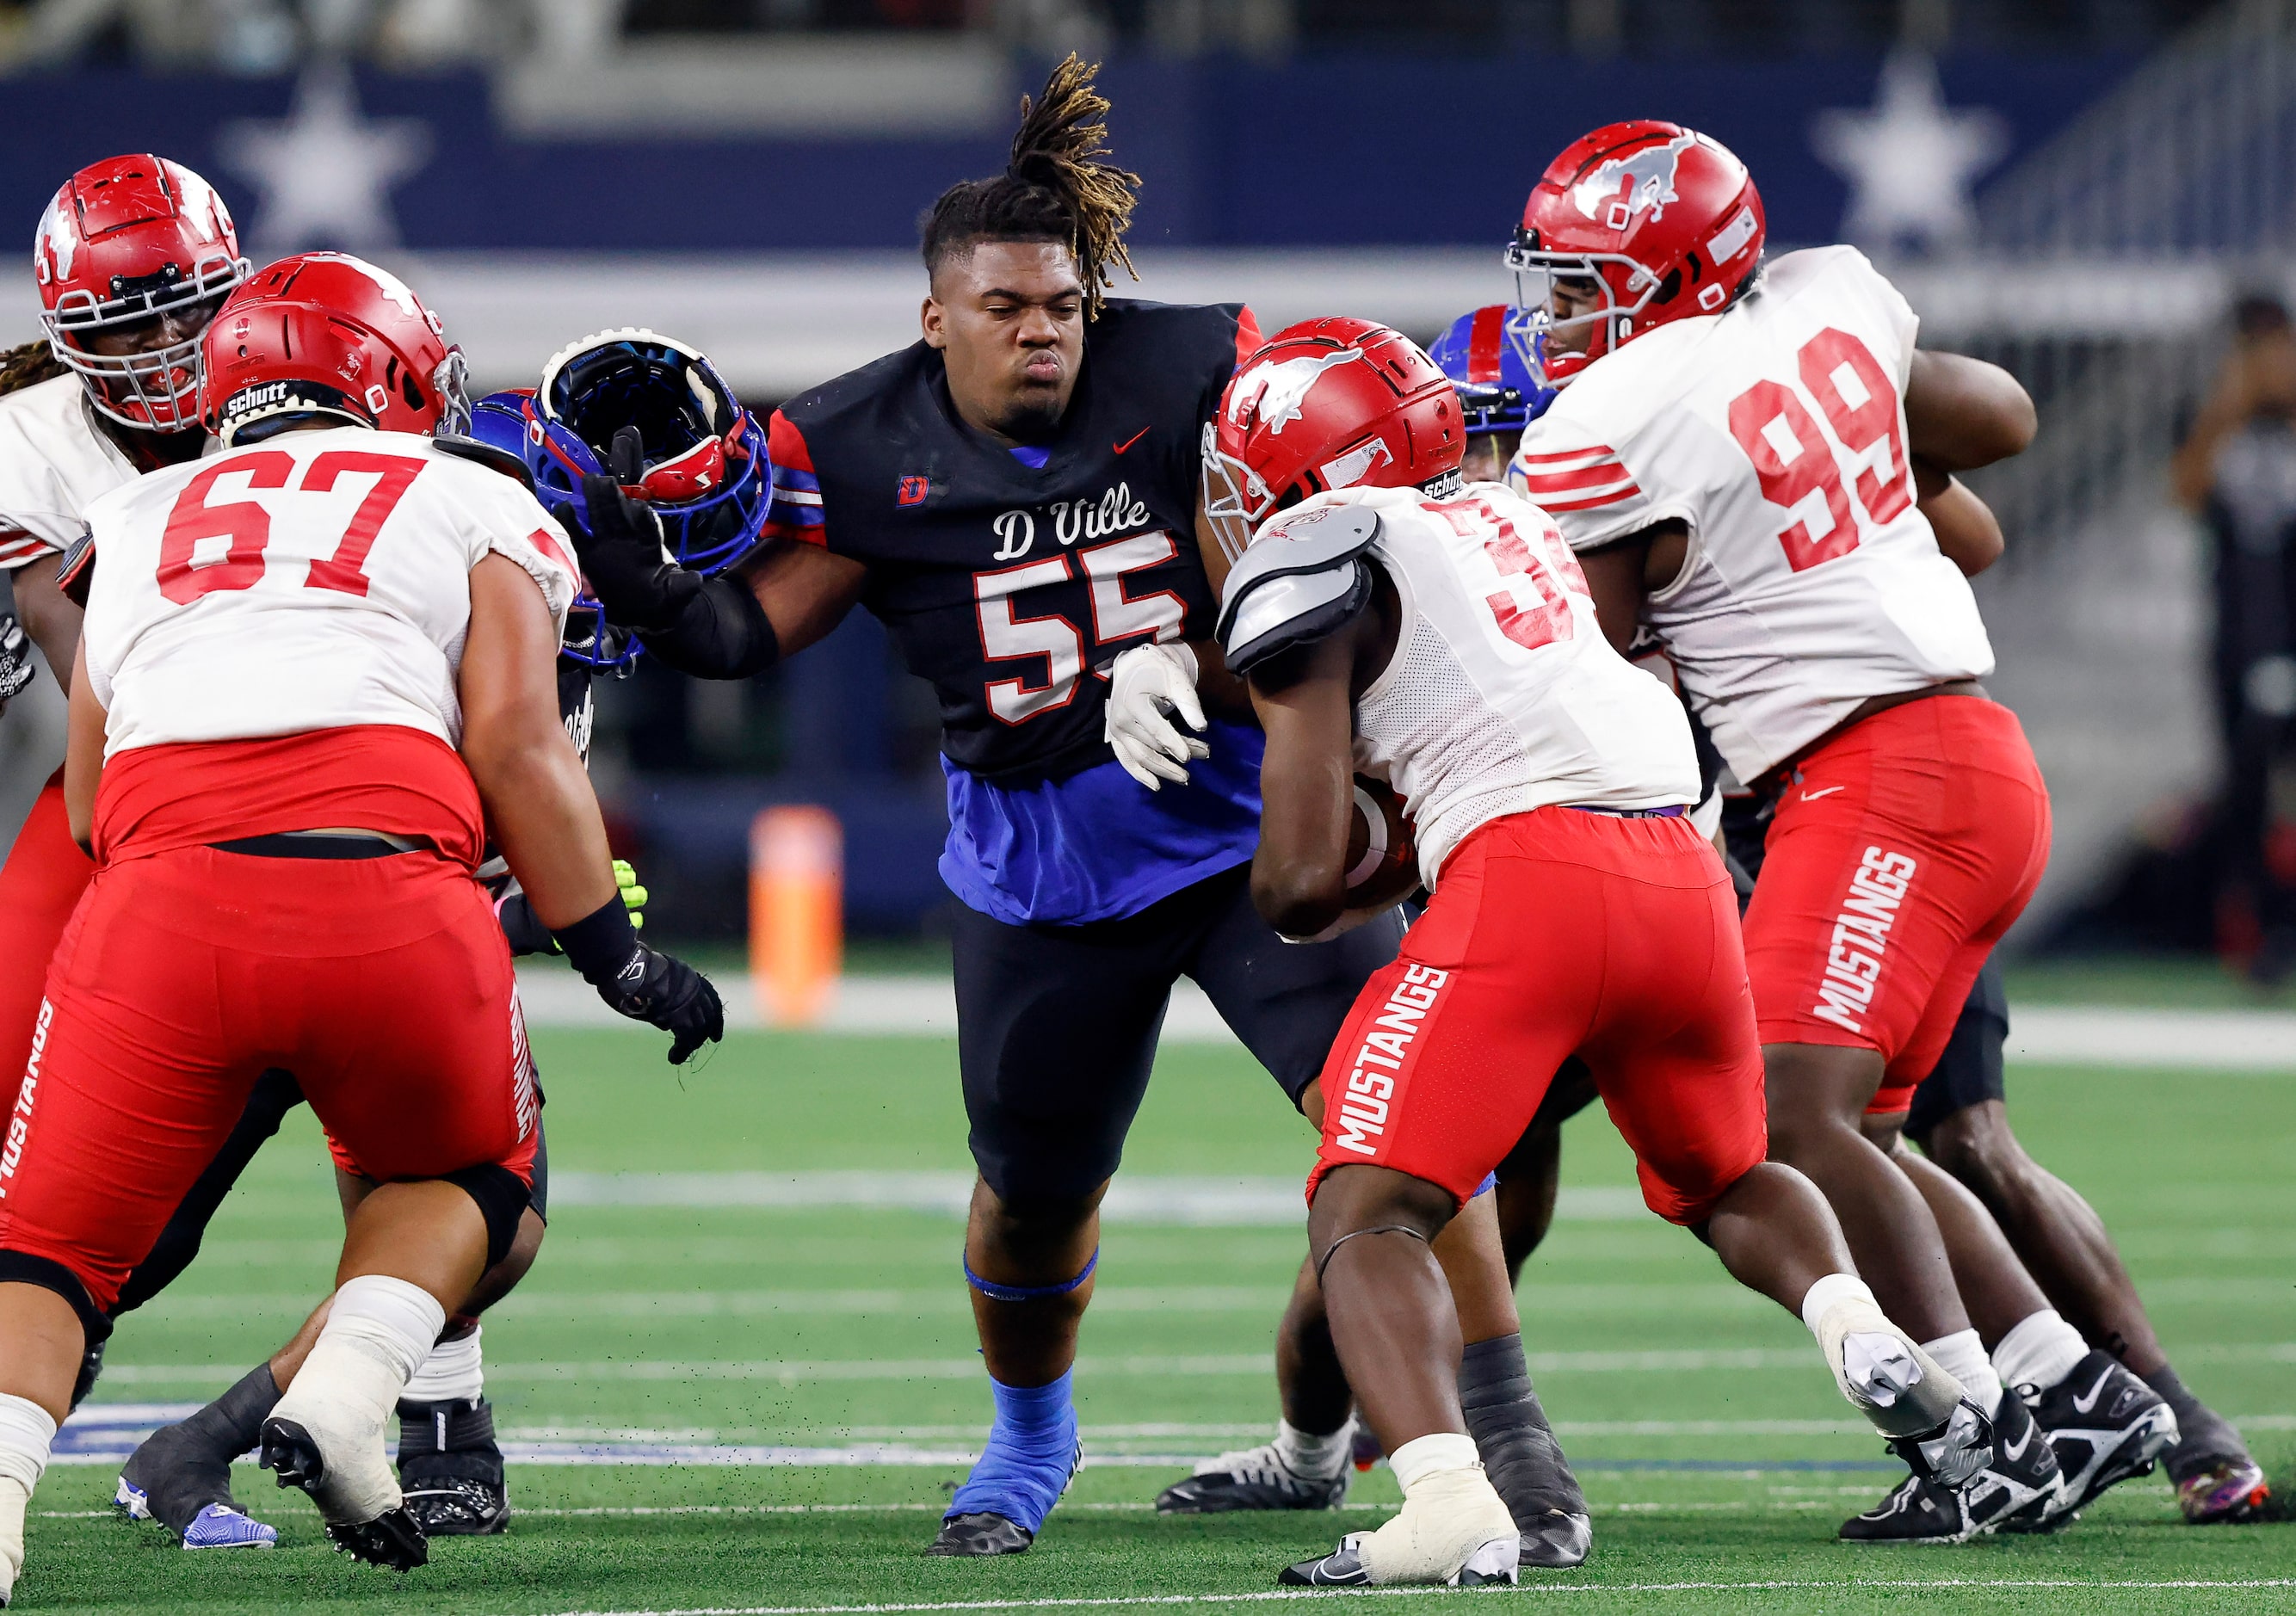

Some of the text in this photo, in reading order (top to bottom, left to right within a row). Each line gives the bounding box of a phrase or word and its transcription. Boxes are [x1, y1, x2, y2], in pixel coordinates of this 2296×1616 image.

[227, 381, 287, 417] schutt
[1729, 326, 1915, 572] 99
[157, 450, 428, 606] 67
[972, 528, 1188, 727] 55
[1812, 846, 1917, 1034] MUSTANGS
[1336, 964, 1449, 1156] MUSTANGS
